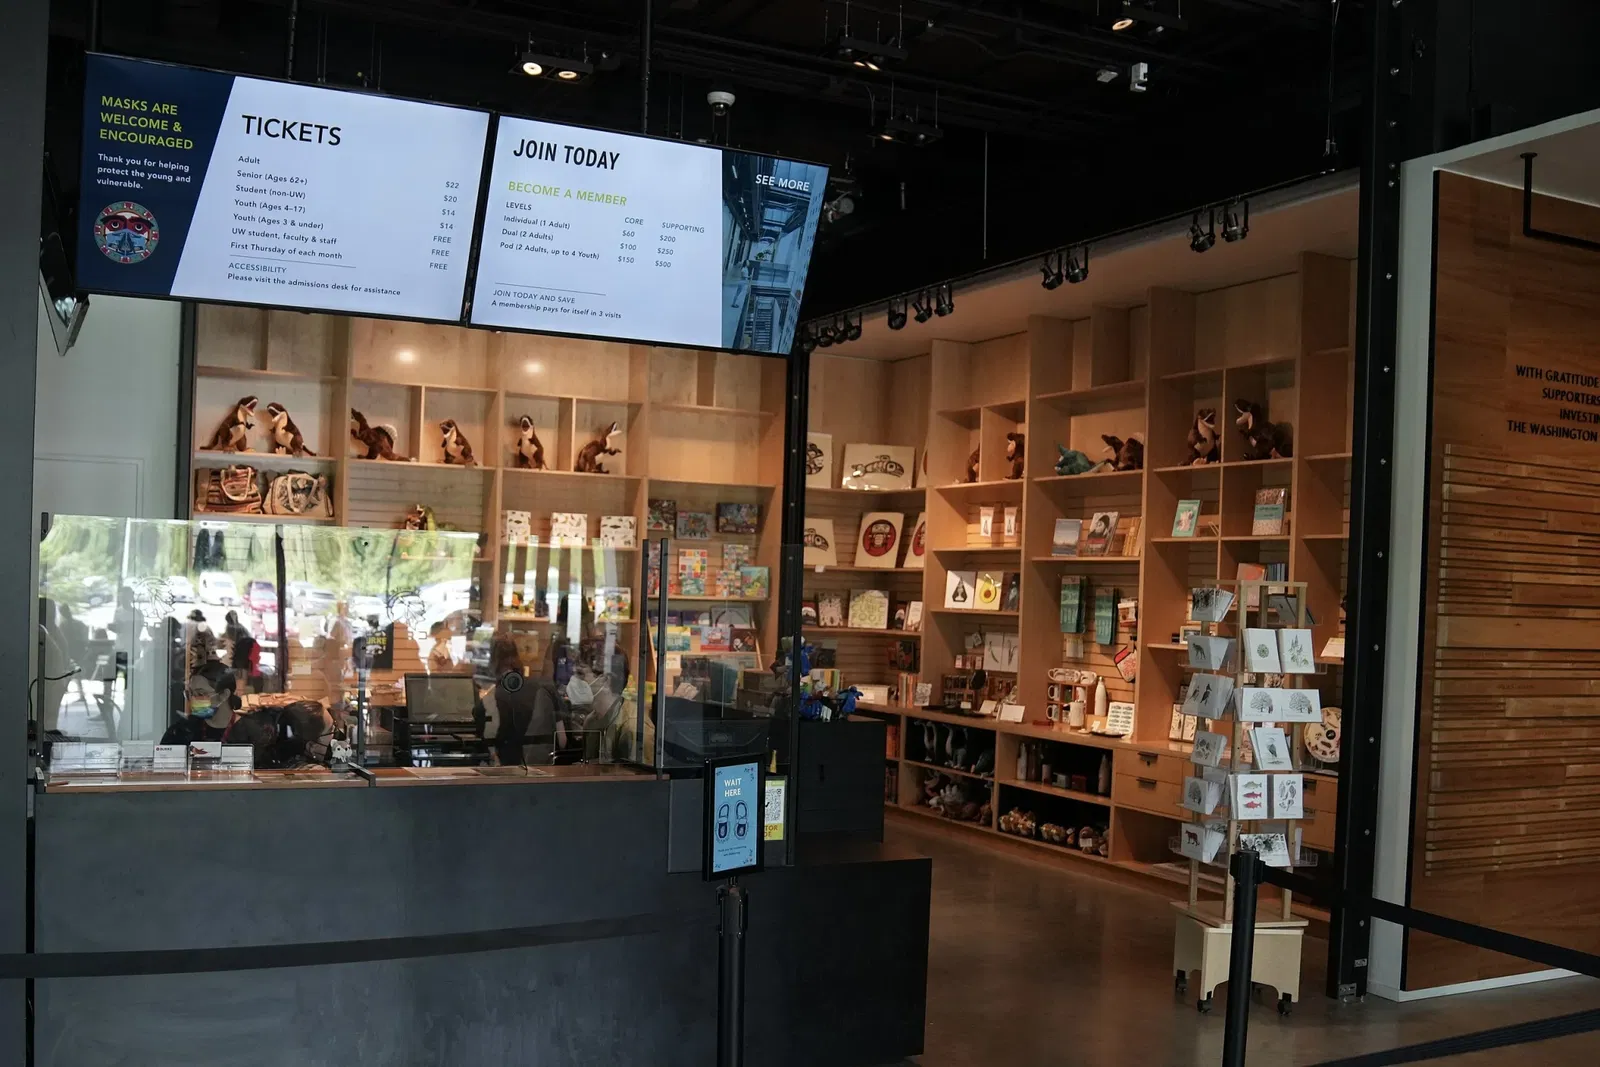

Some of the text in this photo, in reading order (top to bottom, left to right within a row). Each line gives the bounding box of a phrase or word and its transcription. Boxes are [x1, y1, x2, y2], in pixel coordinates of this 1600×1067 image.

[101, 96, 178, 115] MASKS ARE
[100, 112, 182, 132] WELCOME &
[242, 115, 342, 145] TICKETS
[99, 129, 193, 150] ENCOURAGED
[238, 156, 260, 164] Adult
[513, 138, 620, 170] JOIN TODAY
[98, 154, 190, 172] Thank you for helping
[97, 166, 191, 183] protect the young and
[237, 170, 308, 185] Senior (Ages 62+)
[97, 178, 143, 189] vulnerable.
[755, 174, 810, 192] SEE MORE
[236, 184, 306, 200] Student (non-UW)
[508, 181, 627, 206] BECOME A MEMBER
[235, 199, 257, 208] Youth
[260, 202, 282, 212] (Ages
[506, 202, 532, 211] LEVELS
[233, 214, 256, 223] Youth
[258, 216, 281, 226] (Ages
[298, 220, 324, 230] under)
[503, 215, 538, 226] Individual
[549, 220, 570, 229] Adult)
[624, 217, 705, 234] CORE SUPPORTING
[232, 228, 246, 236] UW
[248, 230, 280, 240] student,
[283, 233, 309, 243] faculty
[319, 237, 337, 245] staff
[433, 235, 452, 244] FREE
[502, 229, 518, 237] Dual
[528, 231, 554, 241] Adults)
[622, 229, 676, 243] $60 $200
[230, 242, 343, 260] First Thursday of each month
[431, 249, 450, 257] FREE
[516, 243, 523, 251] (2
[524, 244, 549, 254] Adults,
[578, 250, 600, 260] Youth)
[620, 243, 674, 256] $100 $250
[228, 262, 287, 274] ACCESSIBILITY
[429, 262, 448, 270] FREE
[618, 256, 671, 268] $150 $500
[228, 273, 253, 282] Please
[255, 276, 271, 284] visit
[273, 277, 286, 285] the
[288, 279, 329, 289] admissions
[364, 286, 401, 296] assistance
[499, 301, 541, 311] membership
[513, 292, 537, 300] TODAY
[539, 293, 556, 302] AND
[558, 295, 575, 304] SAVE
[1516, 365, 1600, 388] WITH GRATITUDE
[1542, 388, 1600, 405] SUPPORTERS
[1507, 420, 1598, 442] THE WASHINGTON
[724, 778, 742, 787] WAIT
[724, 788, 741, 797] HERE
